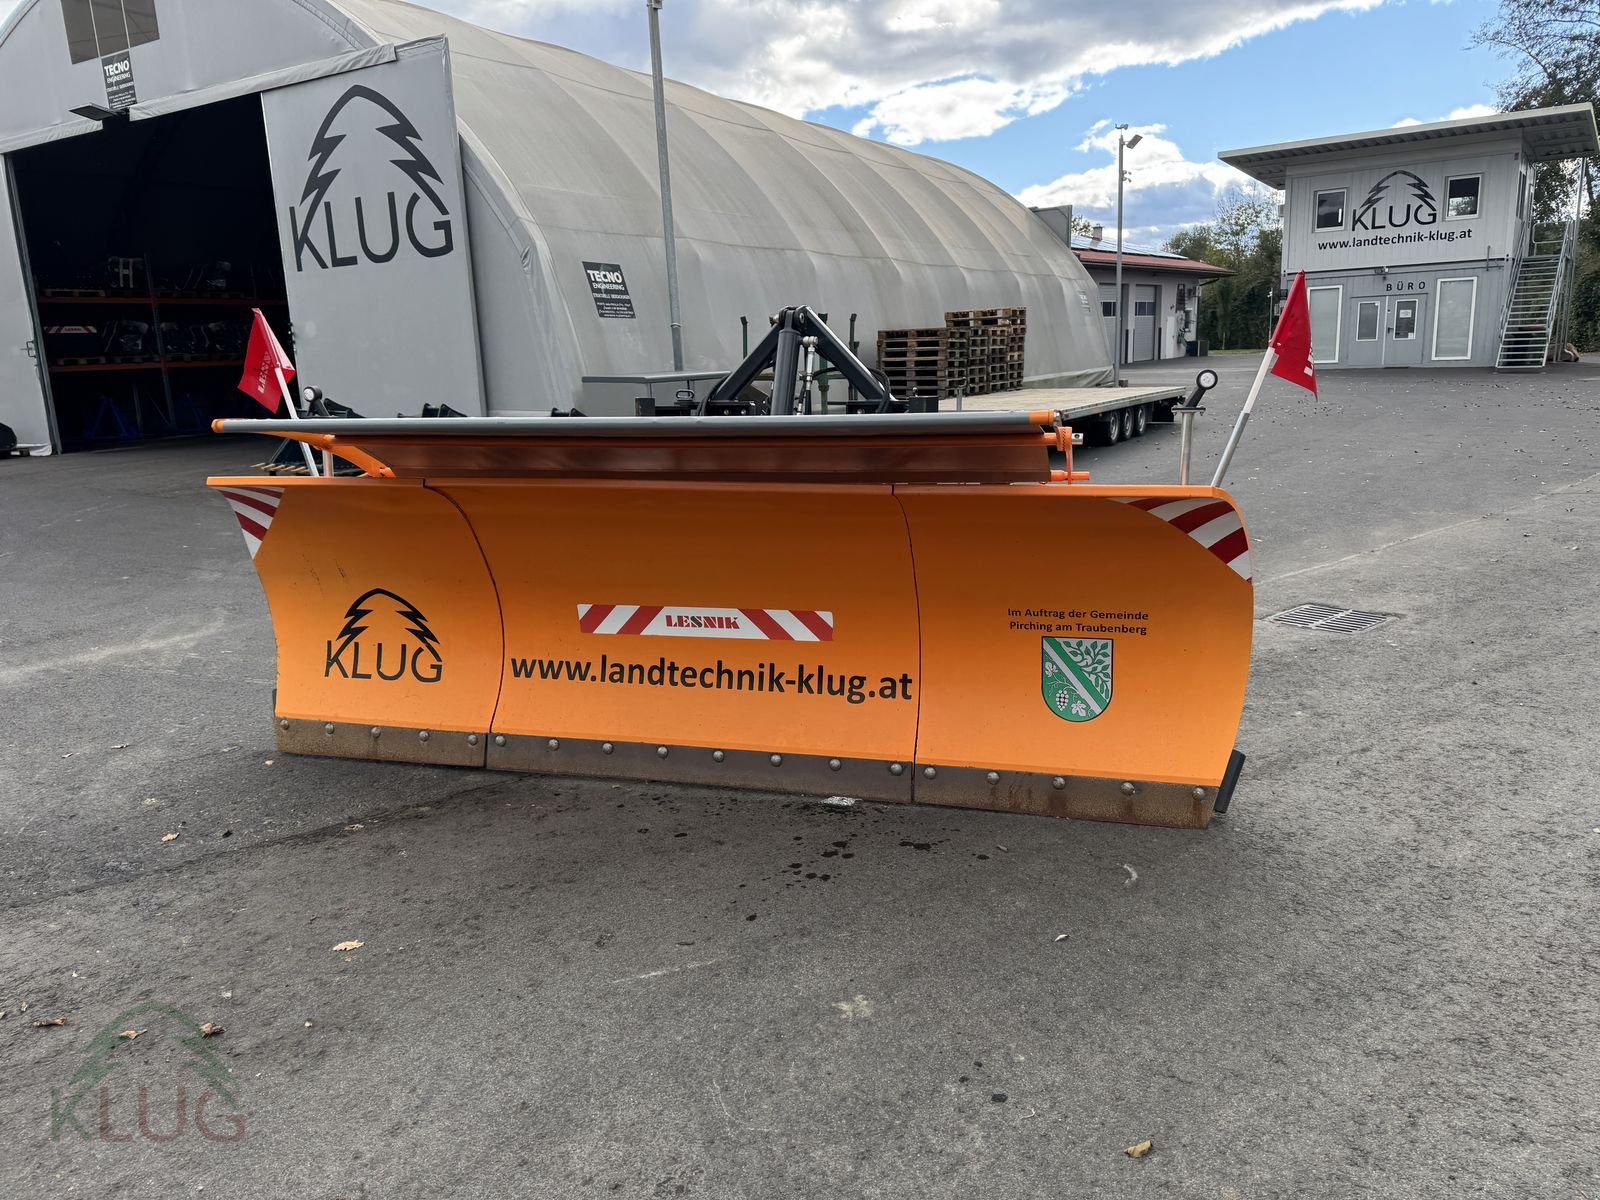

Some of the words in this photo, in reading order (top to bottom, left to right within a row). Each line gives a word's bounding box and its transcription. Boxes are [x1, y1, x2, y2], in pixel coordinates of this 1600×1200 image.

[104, 60, 130, 76] TECNO
[1352, 203, 1437, 231] KLUG
[289, 191, 454, 272] KLUG
[1318, 228, 1473, 250] www.landtechnik-klug.at
[587, 270, 622, 283] TECNO
[1386, 281, 1426, 292] BÜRO
[665, 614, 740, 630] LESNIK
[1008, 608, 1021, 617] Im
[1024, 609, 1065, 619] Auftrag
[1068, 609, 1087, 618] der
[1090, 610, 1149, 620] Gemeinde
[1009, 621, 1052, 632] Pirching
[1055, 624, 1072, 632] am
[1075, 623, 1147, 636] Traubenberg
[324, 640, 442, 682] KLUG
[511, 654, 913, 704] www.landtechnik-klug.at
